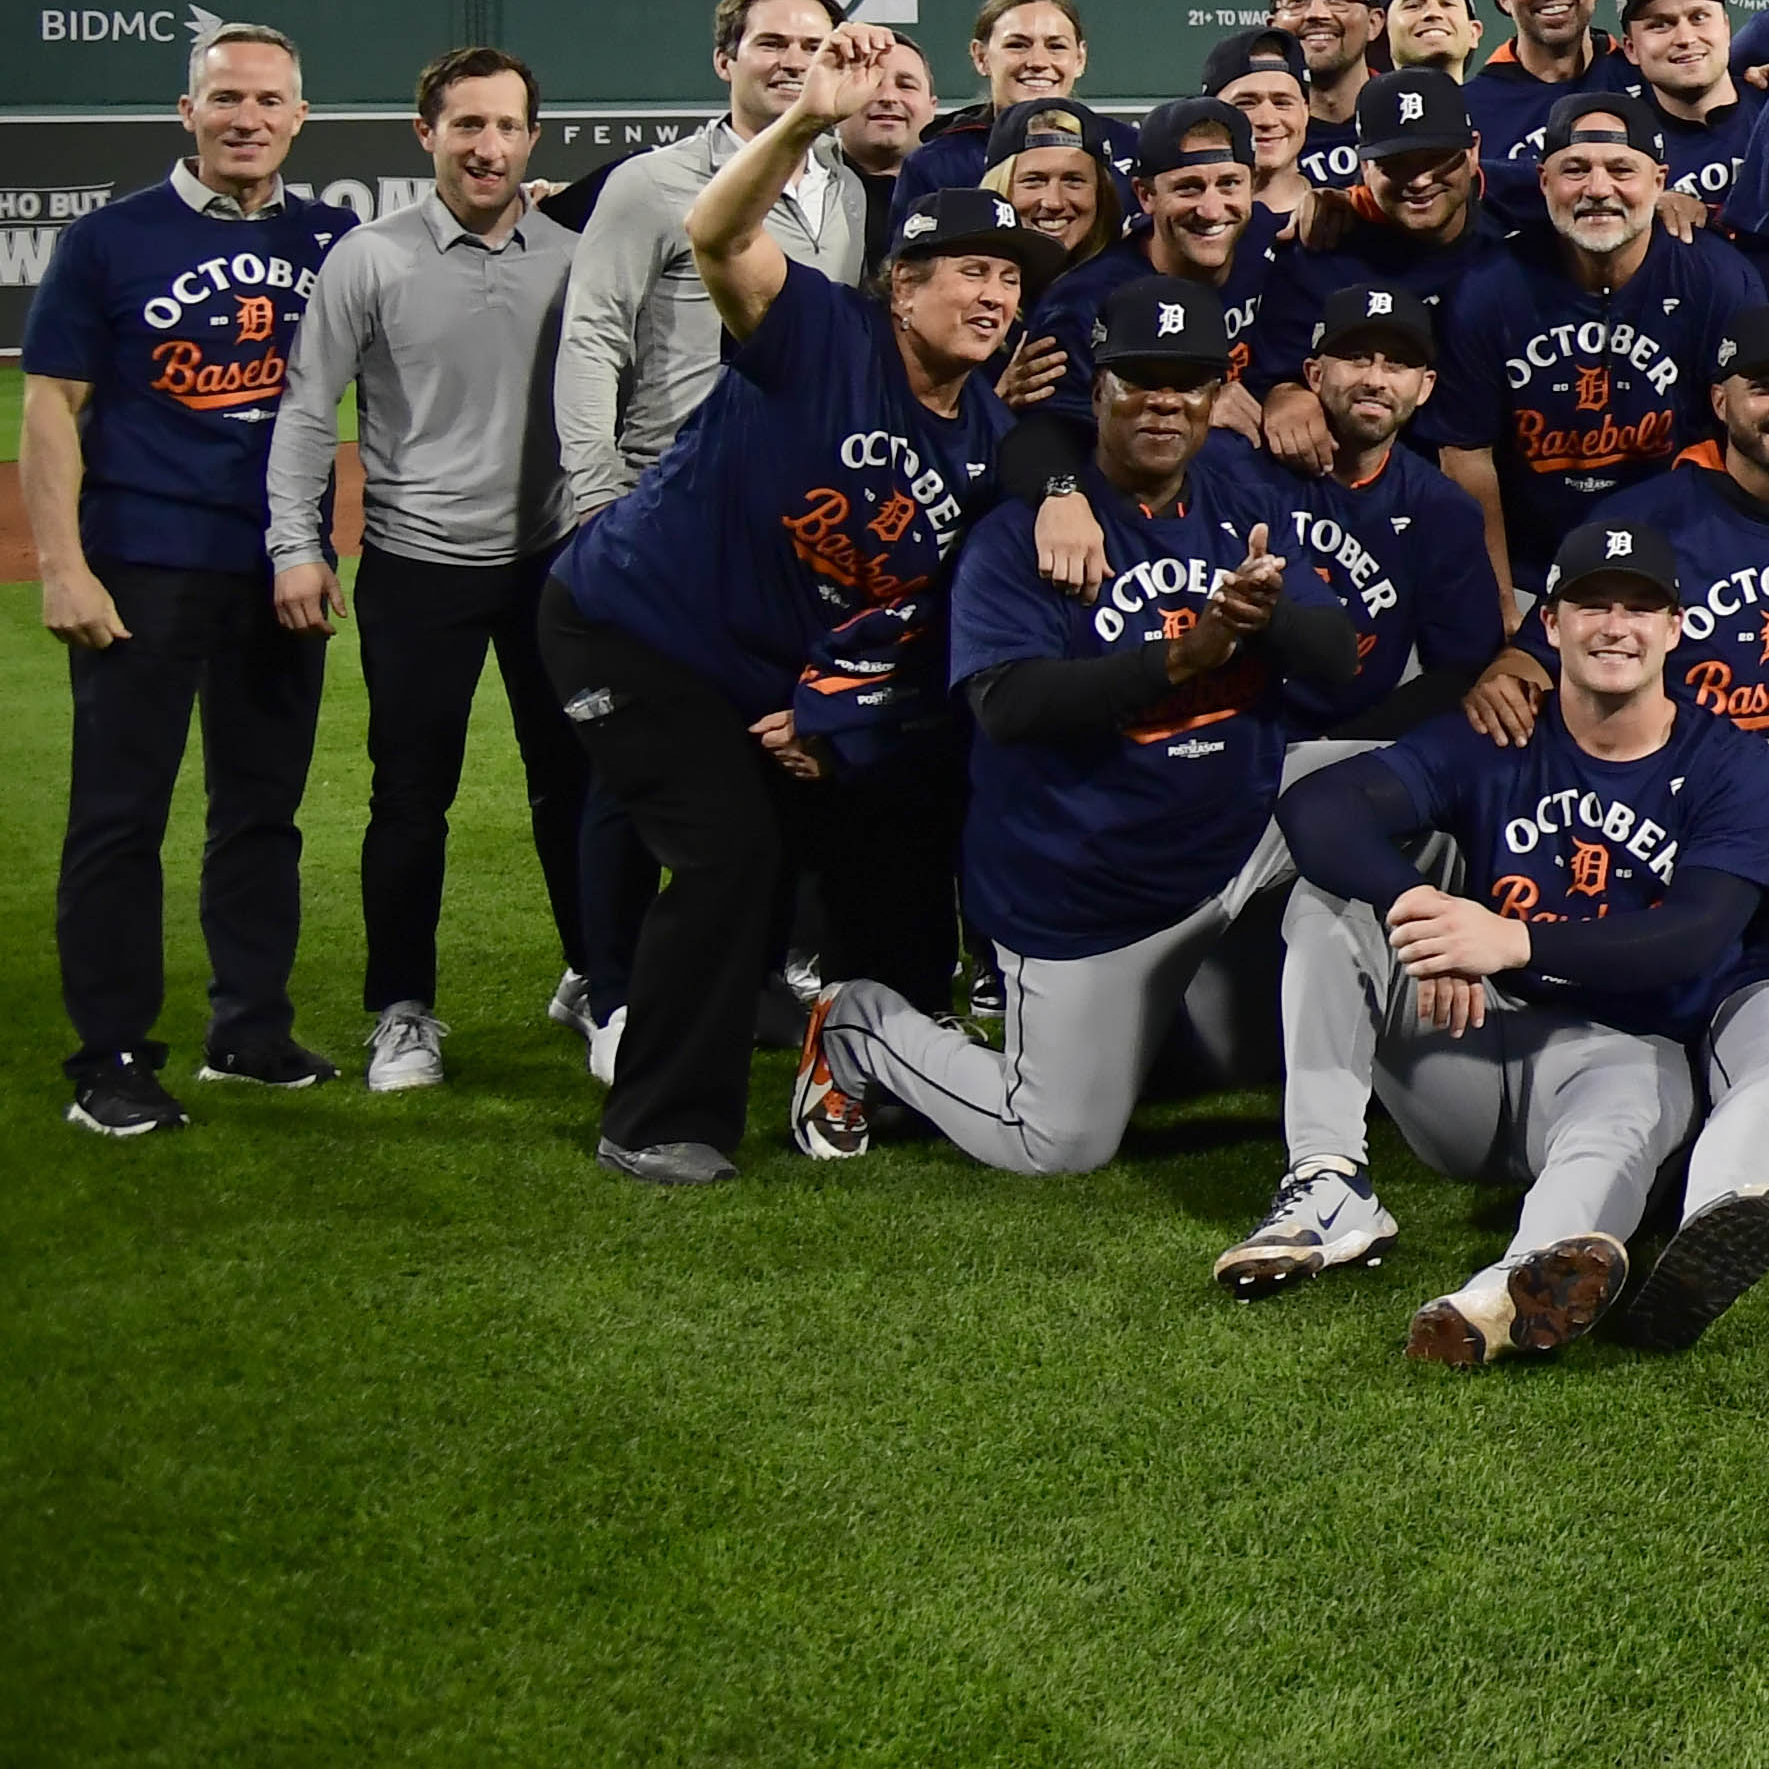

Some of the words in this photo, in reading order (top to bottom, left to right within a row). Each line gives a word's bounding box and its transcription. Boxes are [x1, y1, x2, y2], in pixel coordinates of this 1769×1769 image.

[41, 9, 176, 43] BIDMC
[1187, 9, 1213, 26] 21+
[1216, 10, 1237, 26] TO
[50, 190, 108, 216] BUT
[1506, 320, 1679, 396] OCTOBER
